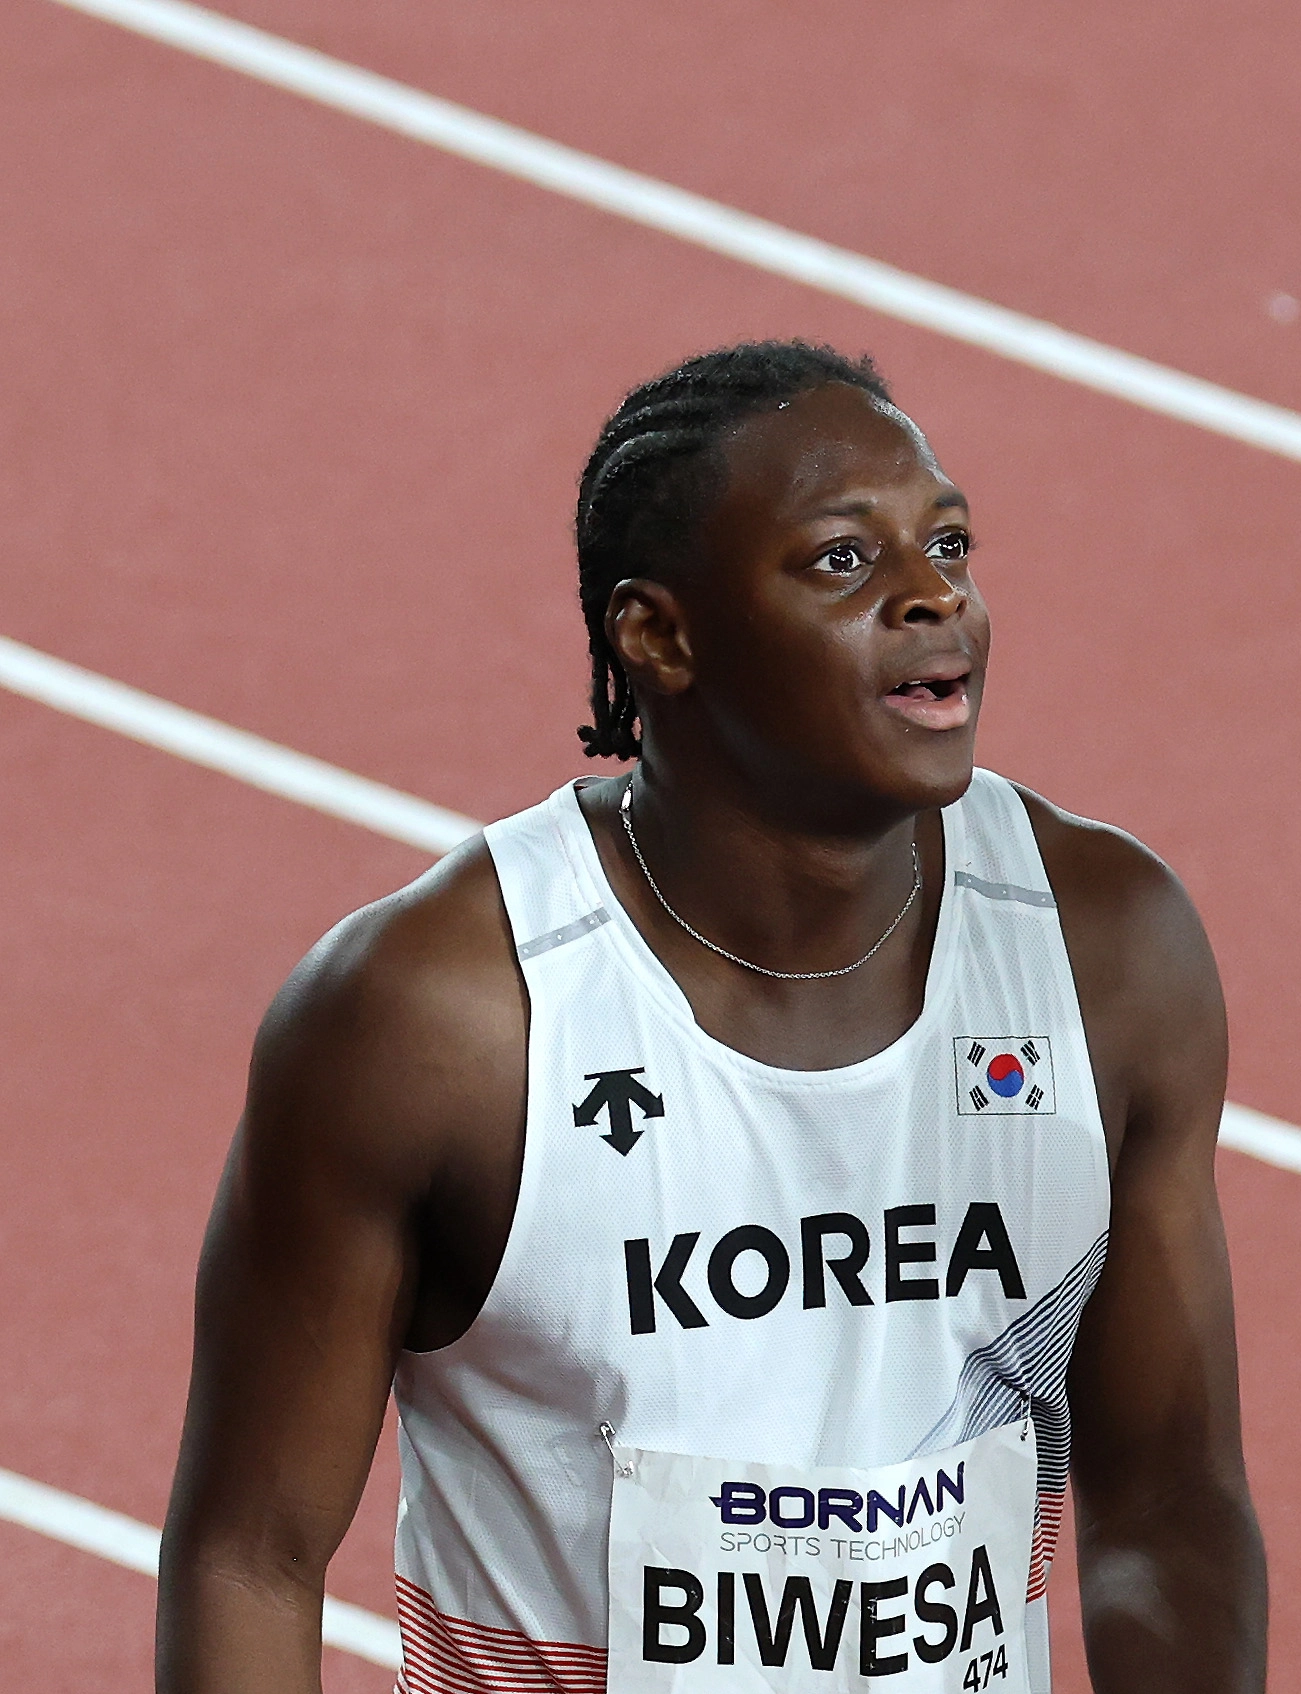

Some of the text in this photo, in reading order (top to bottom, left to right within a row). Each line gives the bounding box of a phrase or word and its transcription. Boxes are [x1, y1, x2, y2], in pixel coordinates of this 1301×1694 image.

[624, 1202, 1027, 1335] KOREA
[708, 1460, 965, 1534] BORNAN
[720, 1512, 966, 1561] SPORTS TECHNOLOGY
[642, 1544, 1004, 1678] BIWESA
[962, 1643, 1009, 1694] 474
